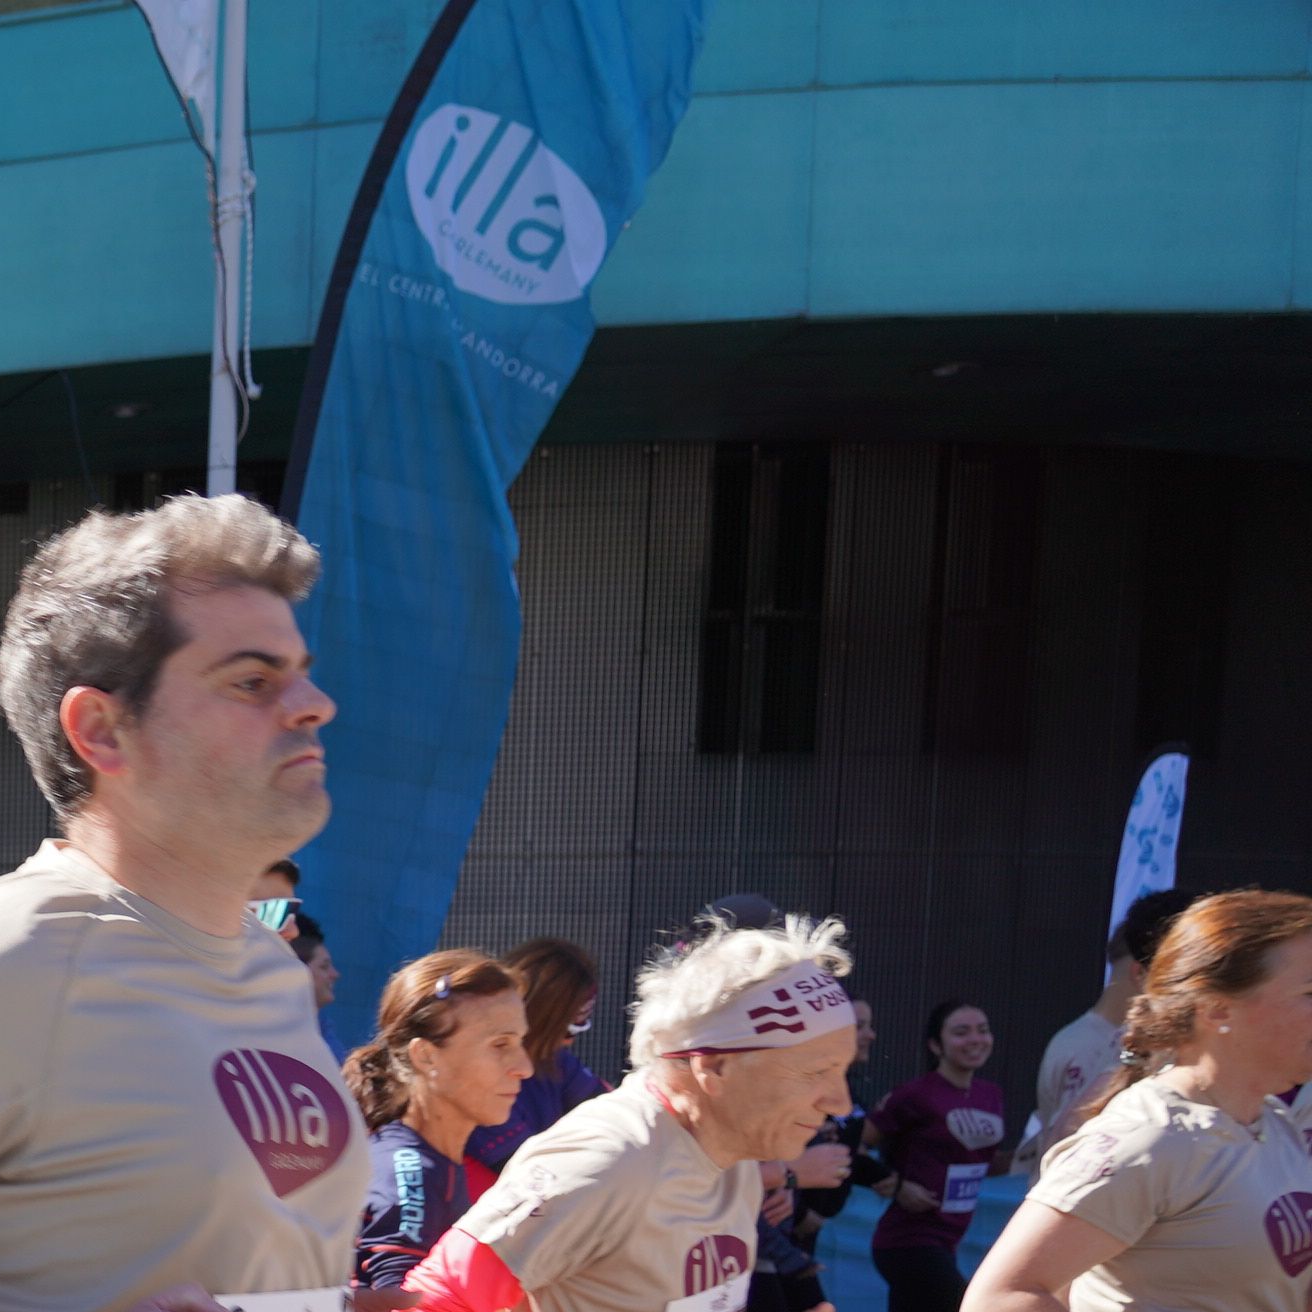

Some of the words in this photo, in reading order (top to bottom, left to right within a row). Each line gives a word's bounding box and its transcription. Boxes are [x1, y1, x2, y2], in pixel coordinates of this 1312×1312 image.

[425, 114, 566, 272] illa
[389, 274, 451, 311] CENTR
[222, 1048, 329, 1148] illa
